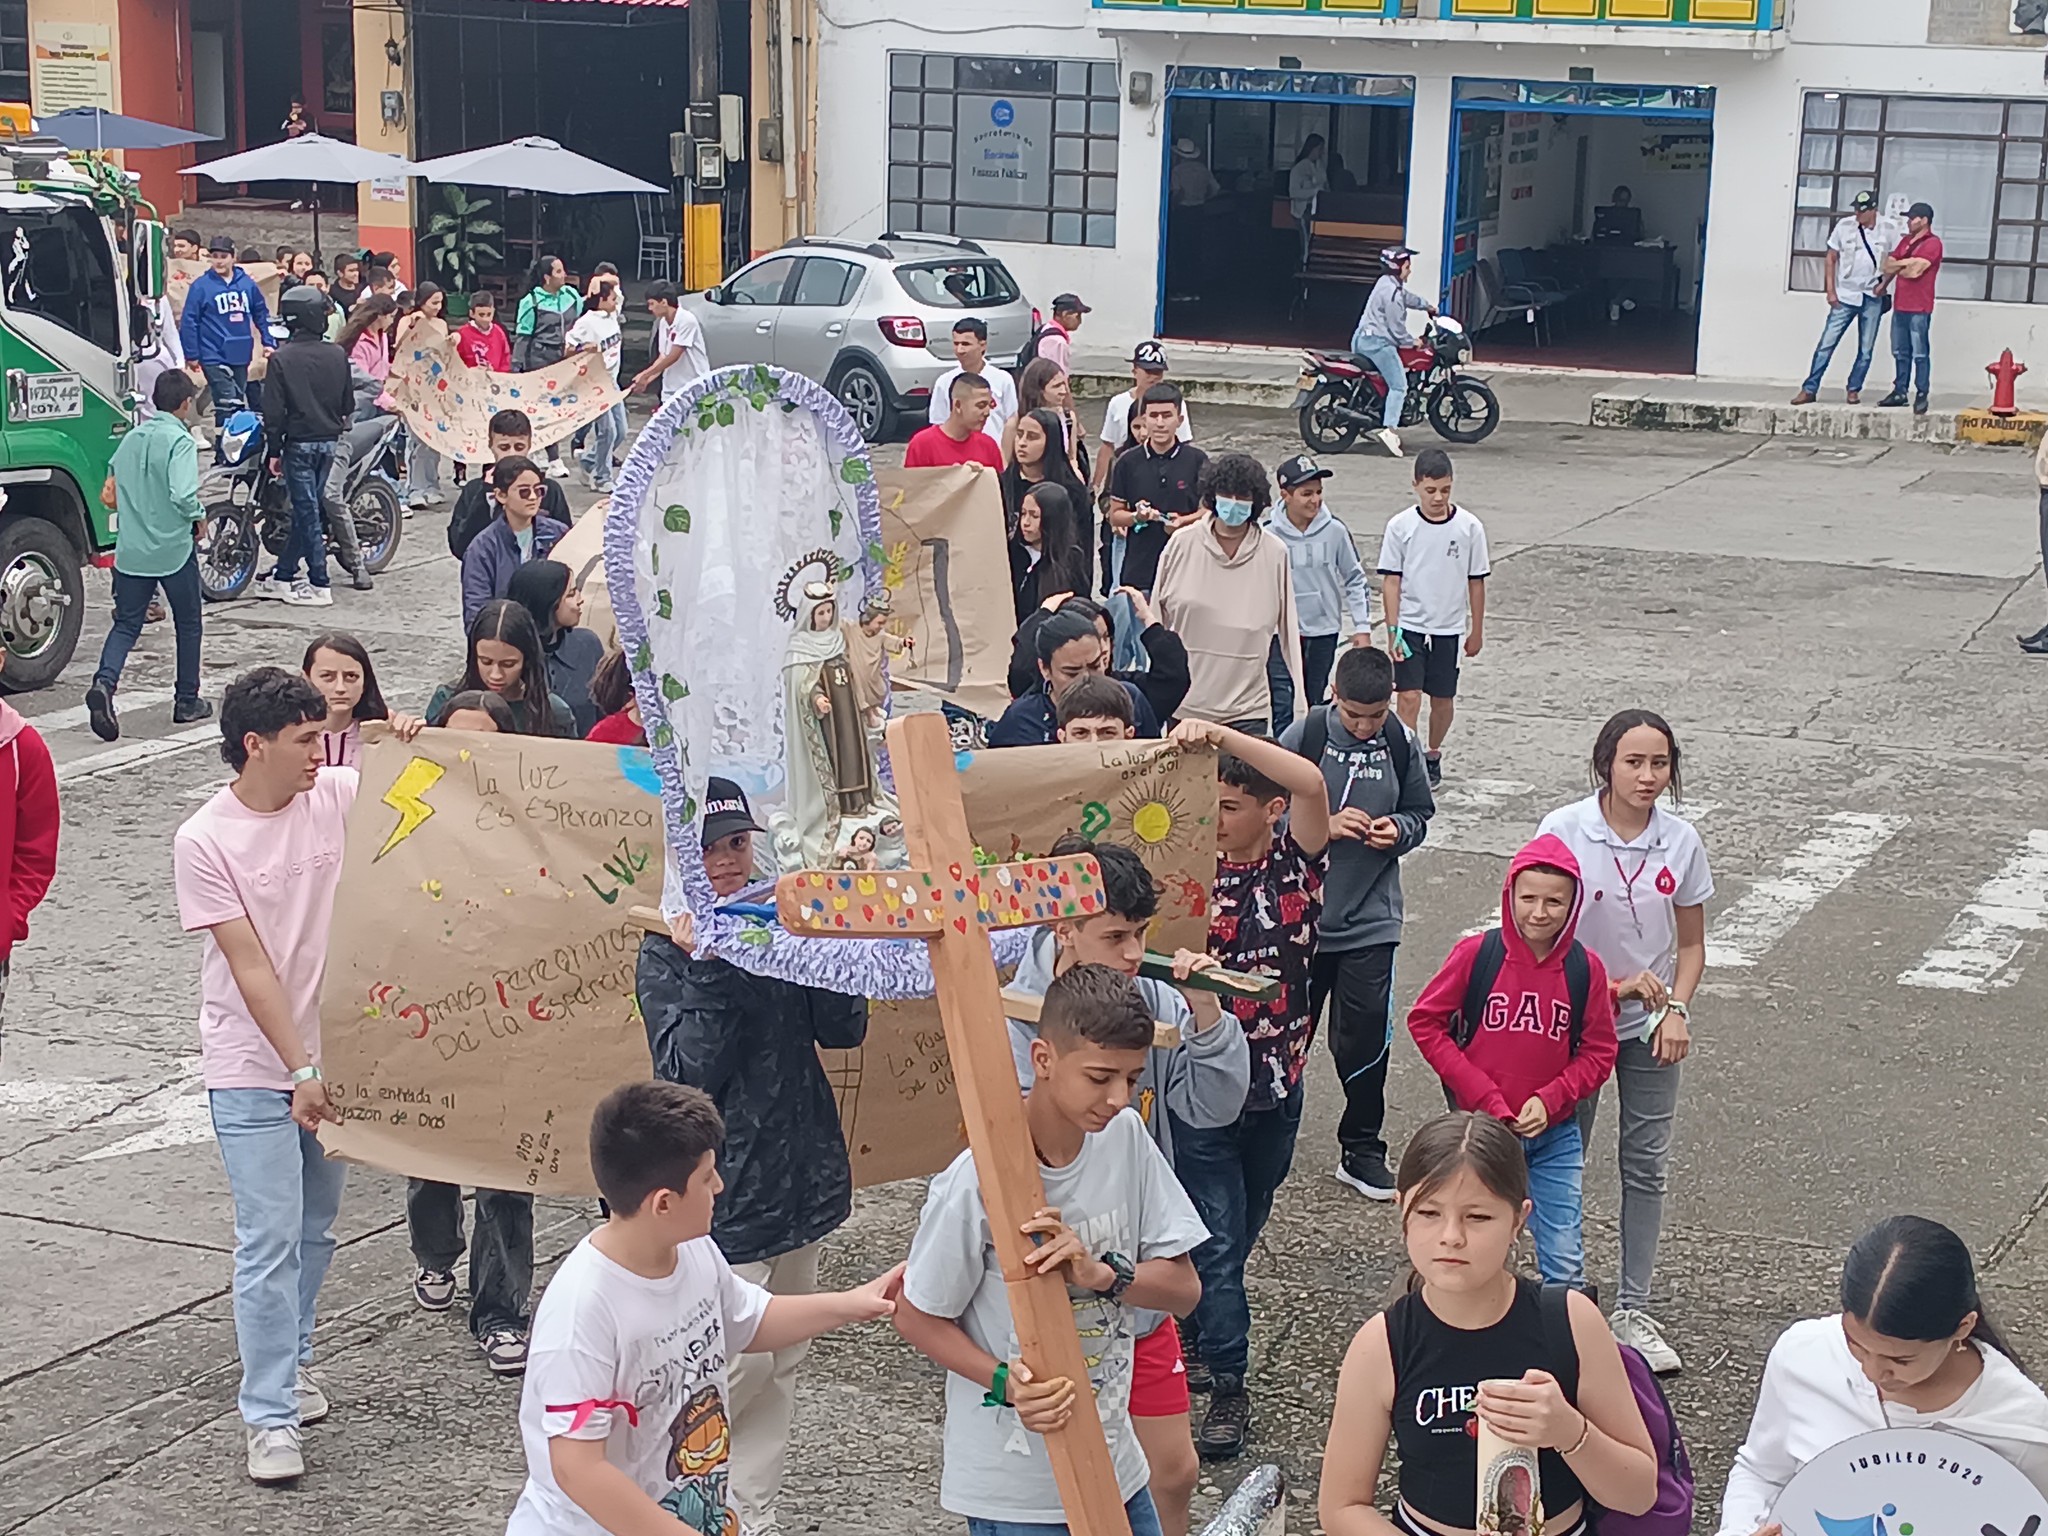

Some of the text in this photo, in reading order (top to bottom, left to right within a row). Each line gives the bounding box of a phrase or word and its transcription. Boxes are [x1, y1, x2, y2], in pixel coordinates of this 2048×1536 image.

[214, 290, 251, 315] USA
[1962, 418, 1978, 429] NO
[1100, 750, 1122, 768] La
[1482, 991, 1572, 1042] GAP
[356, 1083, 369, 1099] la
[379, 1086, 432, 1104] entrada
[1849, 1451, 1984, 1486] JUBILEO 2025
